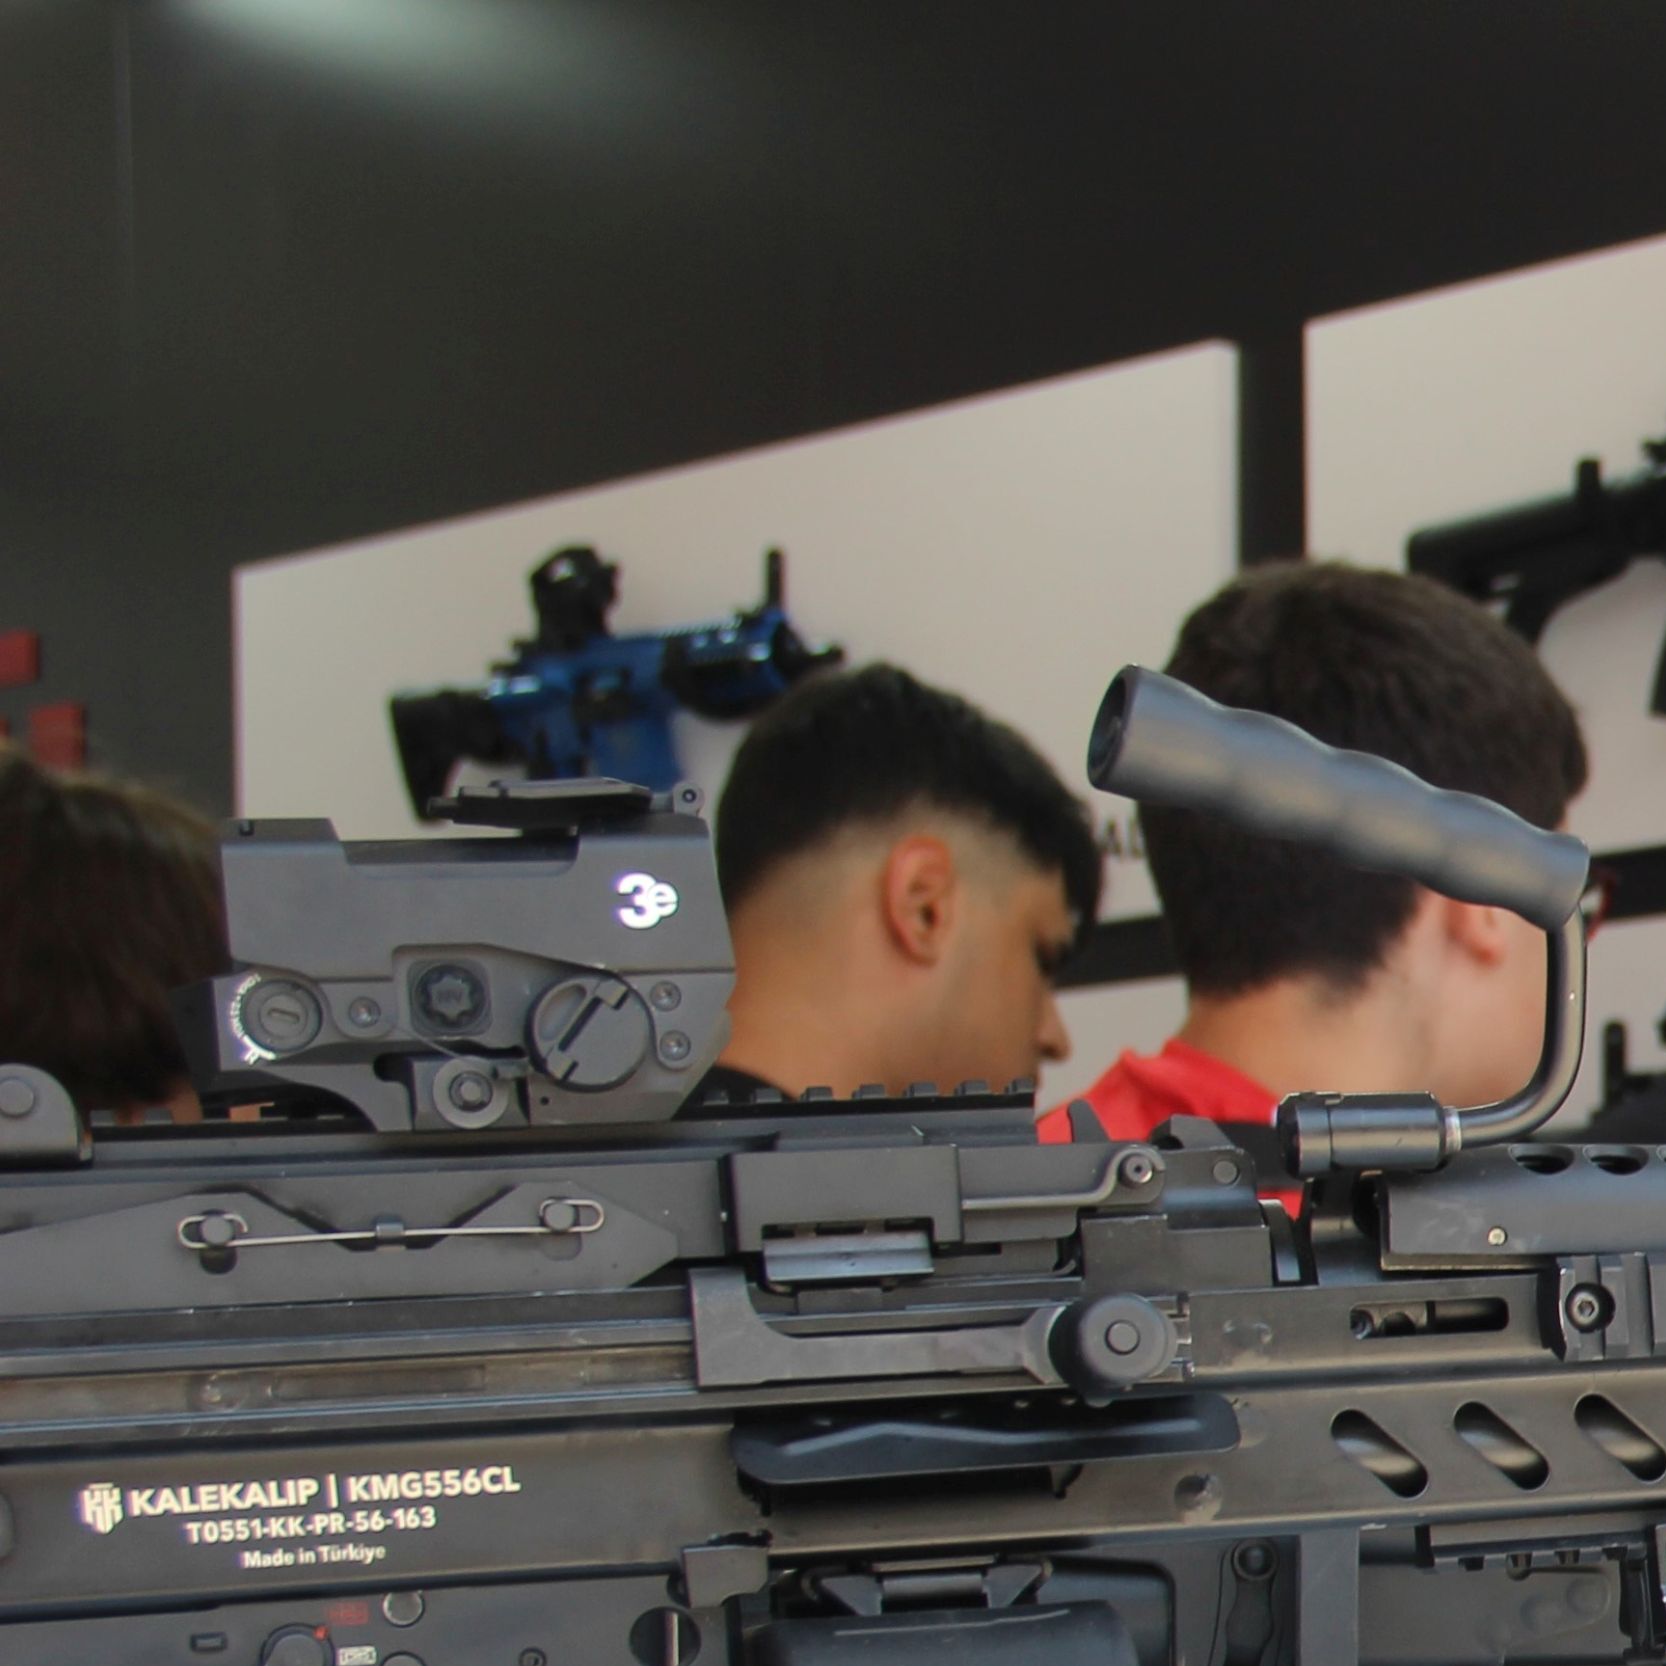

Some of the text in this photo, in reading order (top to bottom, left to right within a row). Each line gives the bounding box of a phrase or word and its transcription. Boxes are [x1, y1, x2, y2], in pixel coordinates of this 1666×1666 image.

[129, 1477, 320, 1518] KALEKALIP
[347, 1465, 522, 1504] KMG556CL
[242, 1542, 387, 1570] Made in Türkiye
